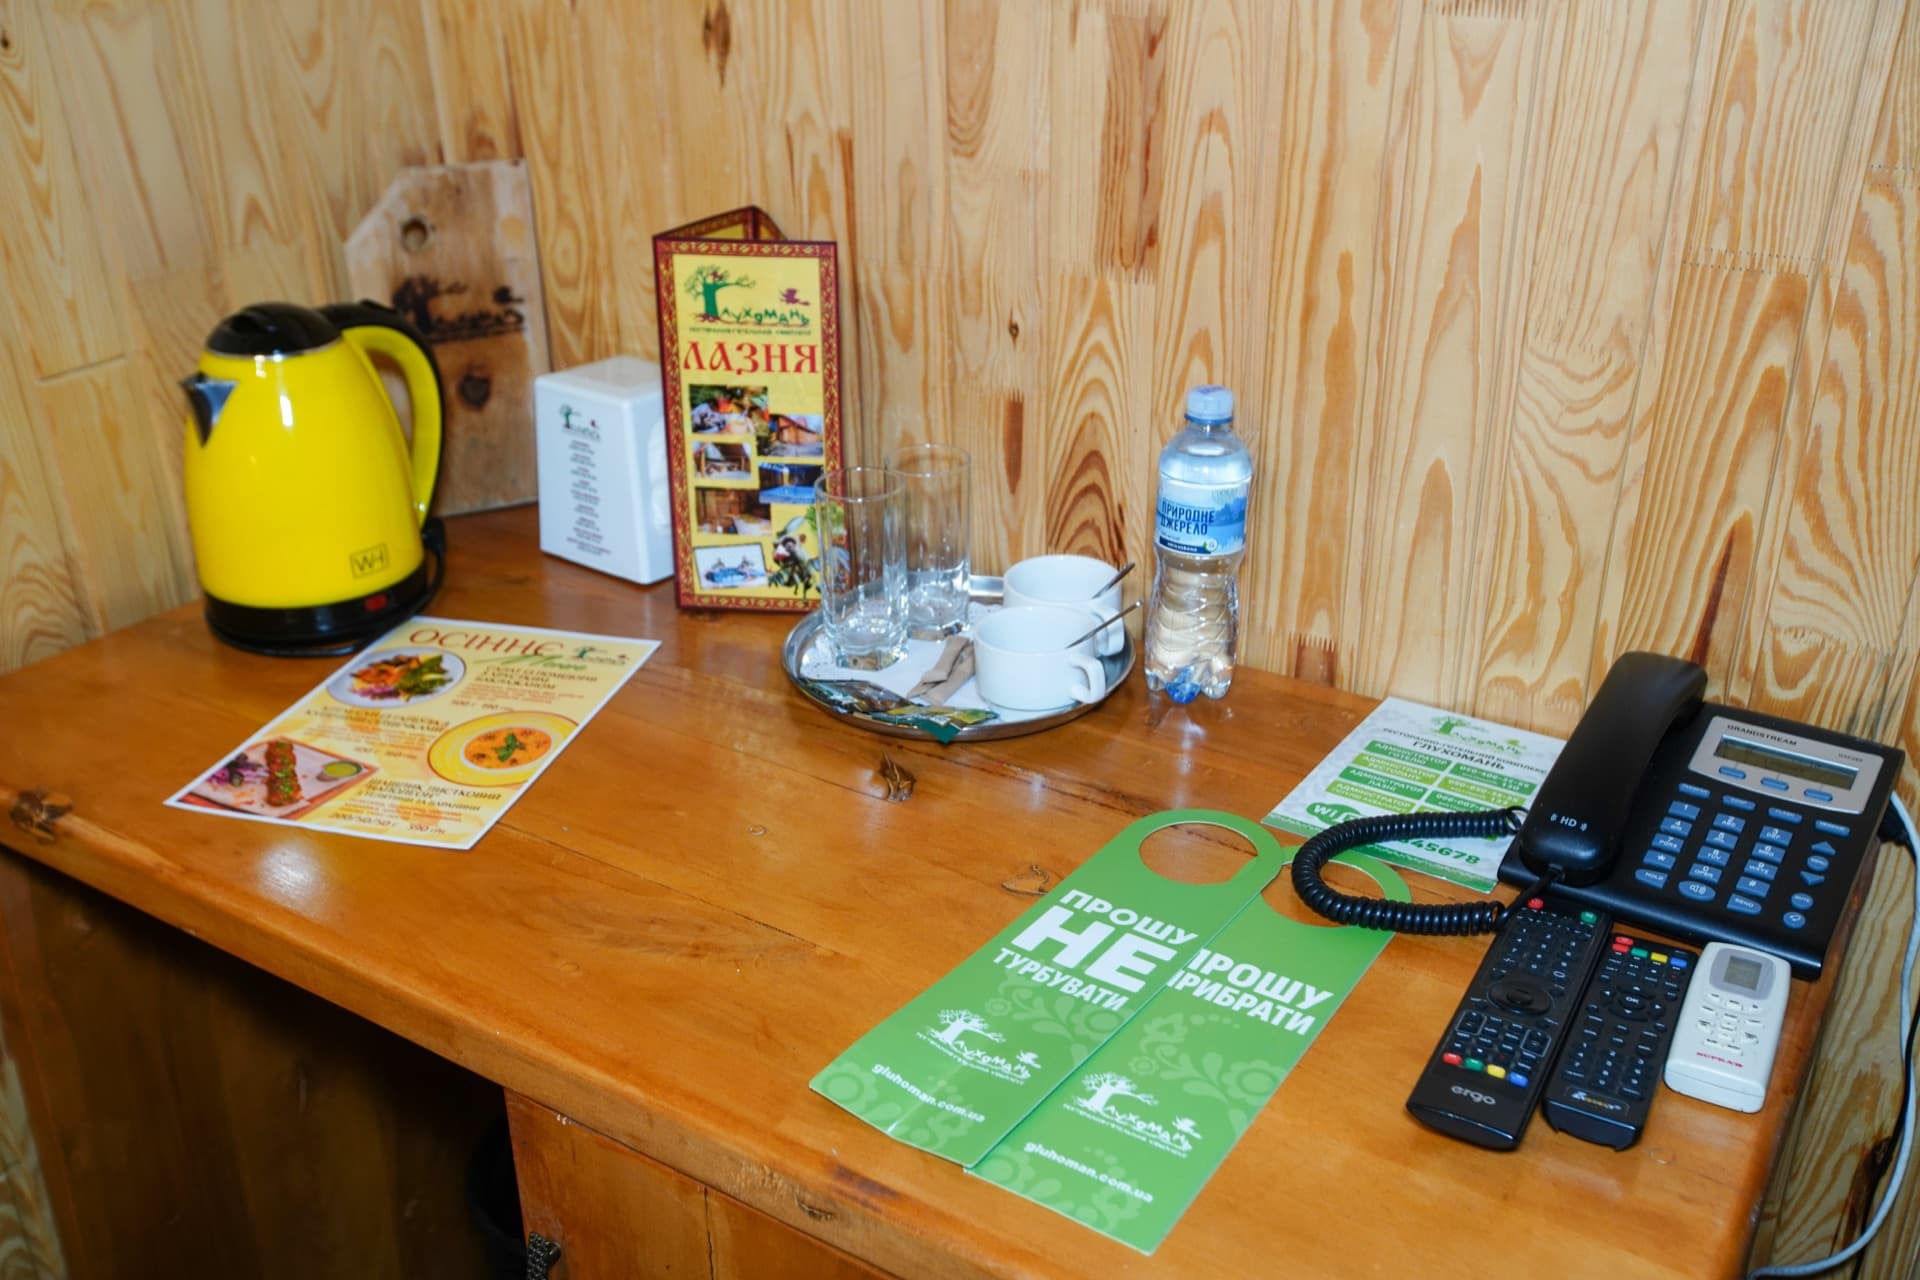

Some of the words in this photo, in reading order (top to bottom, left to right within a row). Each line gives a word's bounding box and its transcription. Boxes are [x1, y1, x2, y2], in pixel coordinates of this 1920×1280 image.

[683, 341, 818, 375] ЛАЗНЯ
[1160, 514, 1208, 535] ДЖЕРЕЛО
[1161, 500, 1215, 523] ПРИРОДНЕ
[1727, 724, 1797, 746] GRANDSTREAM
[1412, 740, 1505, 770] ГЛУХОМАНЬ
[1560, 815, 1577, 827] HD
[1059, 889, 1199, 945] ПРОШУ
[1011, 905, 1178, 993] НЕ
[992, 947, 1129, 1012] ТУРБУВАТИ
[1625, 996, 1639, 1004] OK
[871, 1063, 986, 1123] gluhoman.com.ua
[1451, 1085, 1496, 1105] ergo
[1023, 1141, 1153, 1204] gluhoman.com.ua
